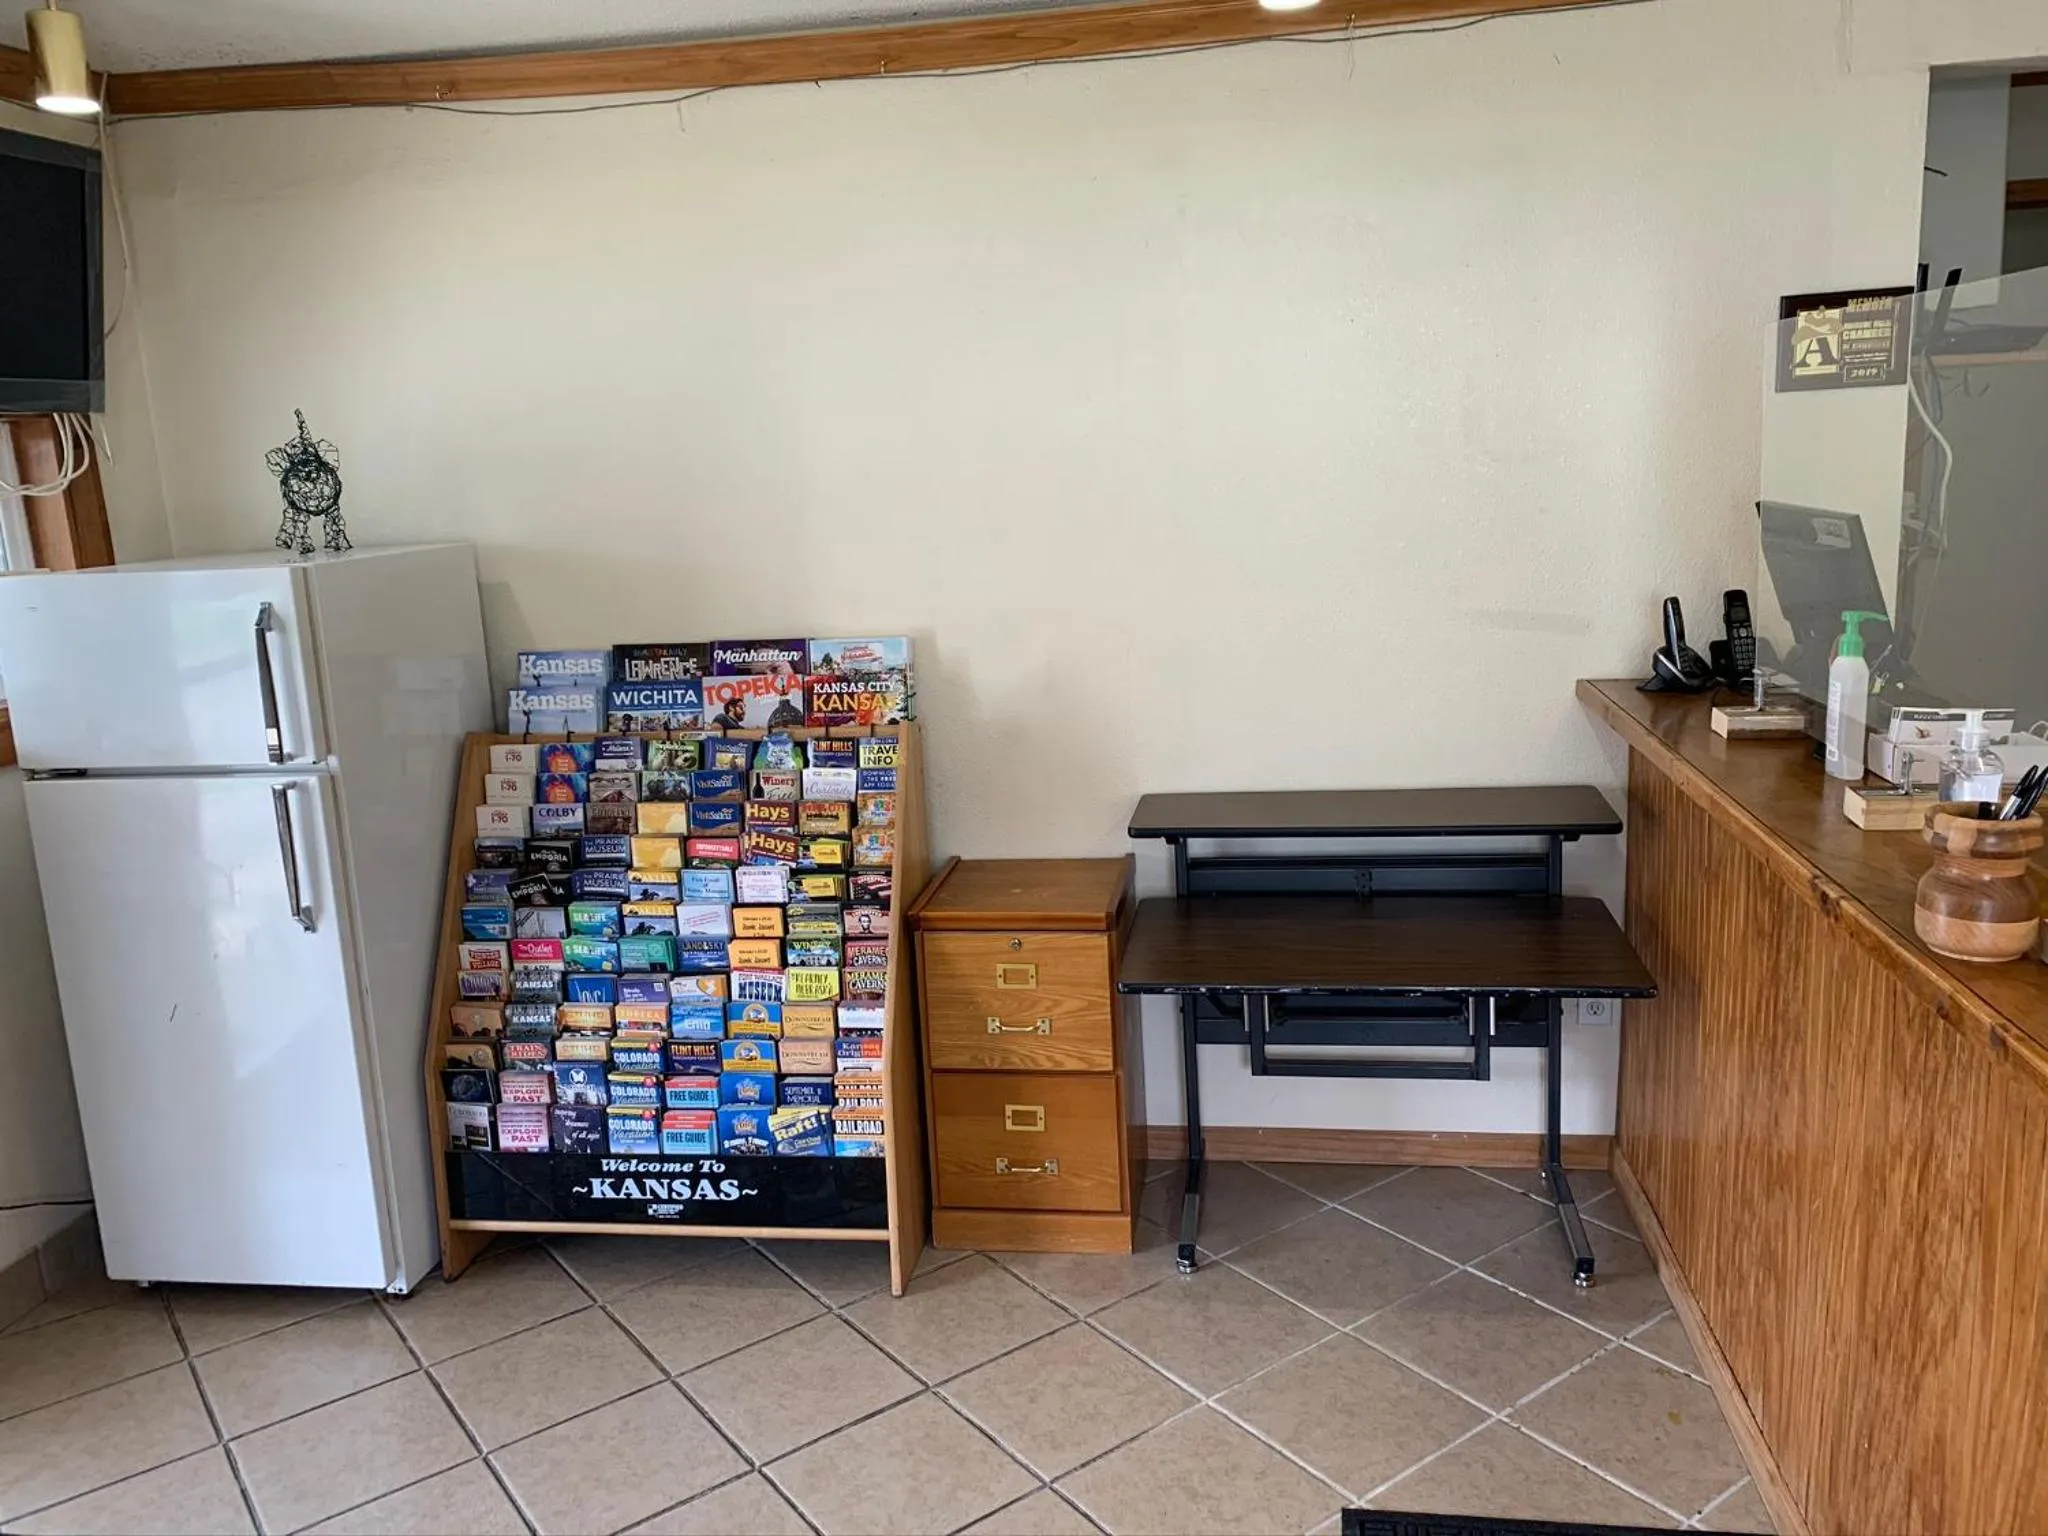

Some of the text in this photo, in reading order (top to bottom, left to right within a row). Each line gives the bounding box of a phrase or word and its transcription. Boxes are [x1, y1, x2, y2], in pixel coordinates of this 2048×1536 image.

[714, 649, 803, 664] Manhattan
[519, 654, 604, 676] Kansas
[625, 657, 698, 682] LAWRENCE
[703, 674, 802, 706] TOPEKA
[813, 681, 896, 693] KANSAS CITY
[509, 690, 596, 711] Kansas
[612, 689, 698, 706] WICHITA
[832, 740, 853, 752] HILLS
[863, 745, 899, 755] TRAVE
[863, 756, 894, 766] INFO
[761, 776, 795, 788] Winery
[538, 808, 577, 818] COLBY
[746, 803, 790, 821] Hays
[750, 832, 796, 854] Hays
[585, 845, 626, 854] MUSEUM
[530, 852, 568, 862] EMPORIA
[583, 879, 625, 888] MUSEUM
[512, 884, 548, 898] EMPORIA
[573, 912, 607, 922] SEA LIFE
[590, 946, 607, 956] LIFE
[847, 946, 886, 957] MERAME
[471, 960, 501, 969] VILLAGE
[853, 955, 887, 967] CAVERNS
[847, 972, 888, 981] MERAME
[515, 981, 554, 989] KANSAS
[849, 980, 886, 991] CAVERN
[738, 981, 782, 1002] MUSEUM
[512, 1015, 551, 1023] KANSAS
[671, 1045, 716, 1056] FLINT HILLS
[613, 1052, 660, 1063] COLORADO
[611, 1086, 657, 1097] COLORADO
[669, 1090, 710, 1101] FREE GUIDE
[608, 1118, 655, 1131] COLORADO
[835, 1120, 883, 1134] RAILROAD
[571, 1130, 579, 1139] of
[579, 1130, 588, 1138] all
[666, 1131, 707, 1144] FREE GUIDE
[600, 1158, 726, 1173] Welcome To
